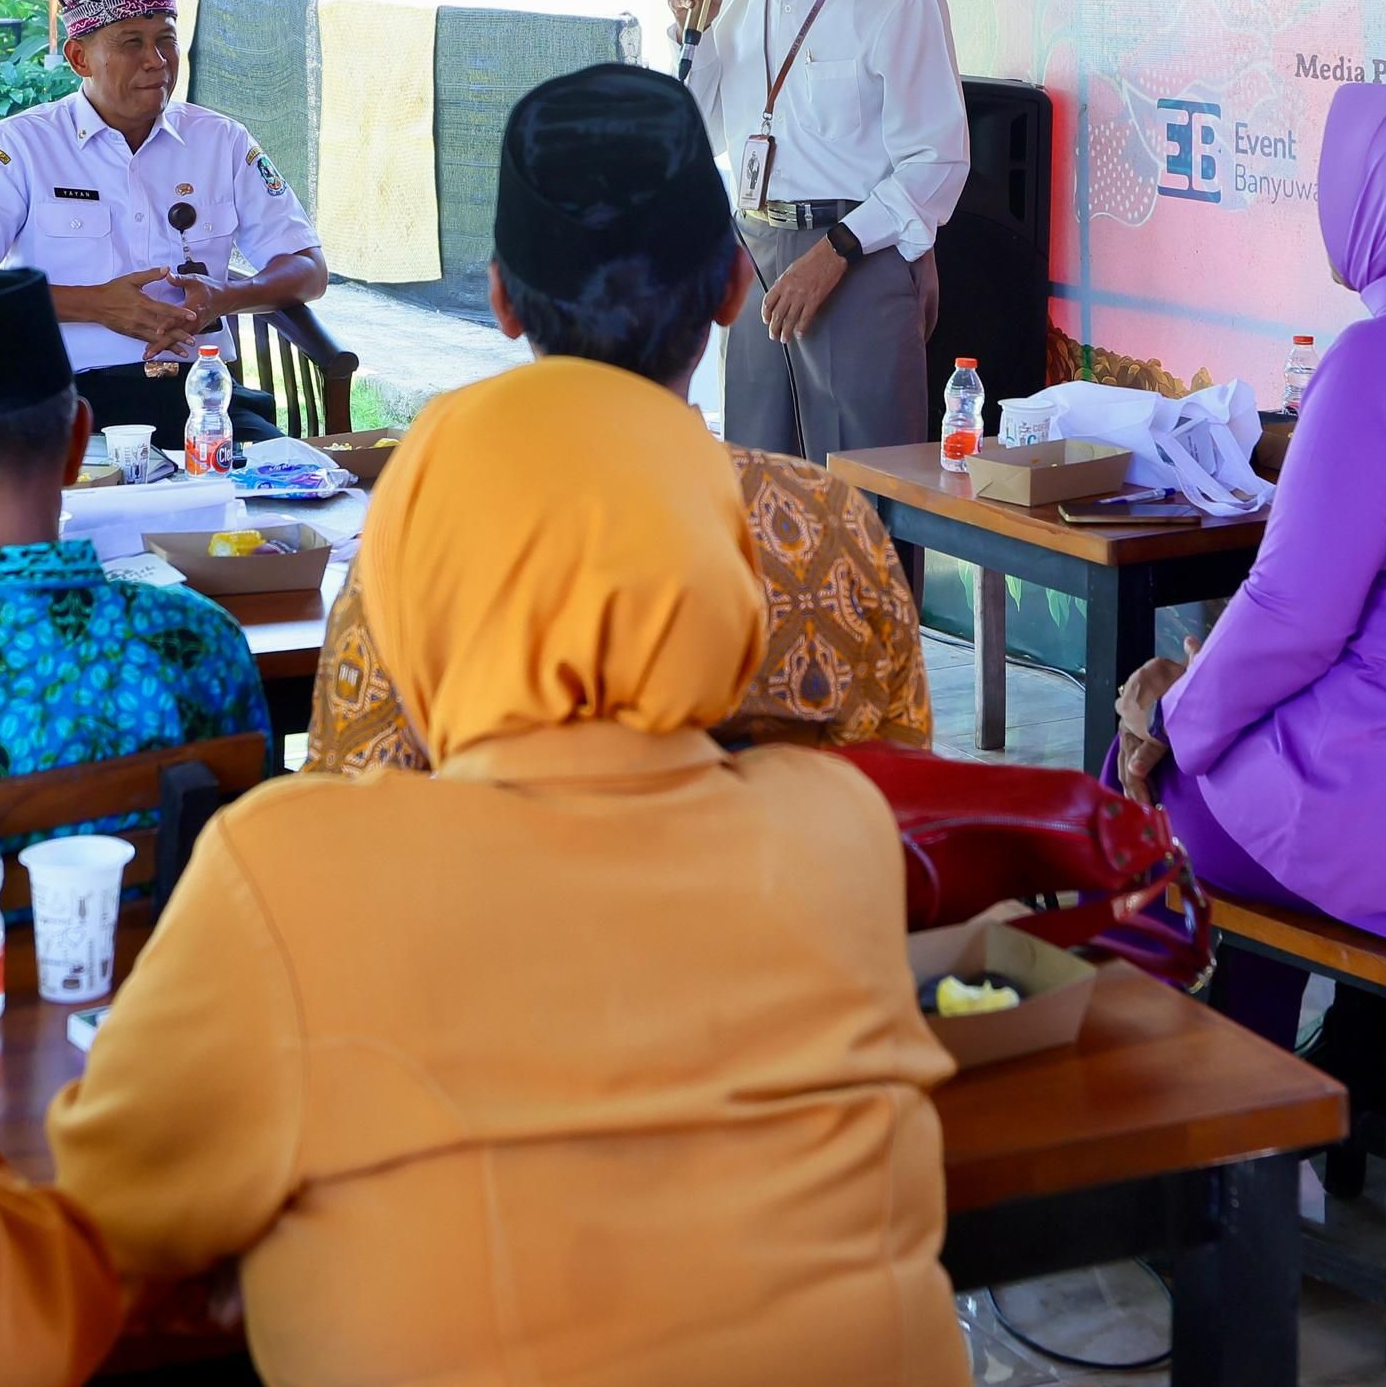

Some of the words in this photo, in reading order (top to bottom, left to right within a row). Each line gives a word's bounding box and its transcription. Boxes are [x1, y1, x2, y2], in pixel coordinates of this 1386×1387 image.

[1295, 53, 1365, 83] Media
[1235, 122, 1297, 160] Event
[63, 190, 90, 198] YAYAN
[219, 448, 232, 463] Cle
